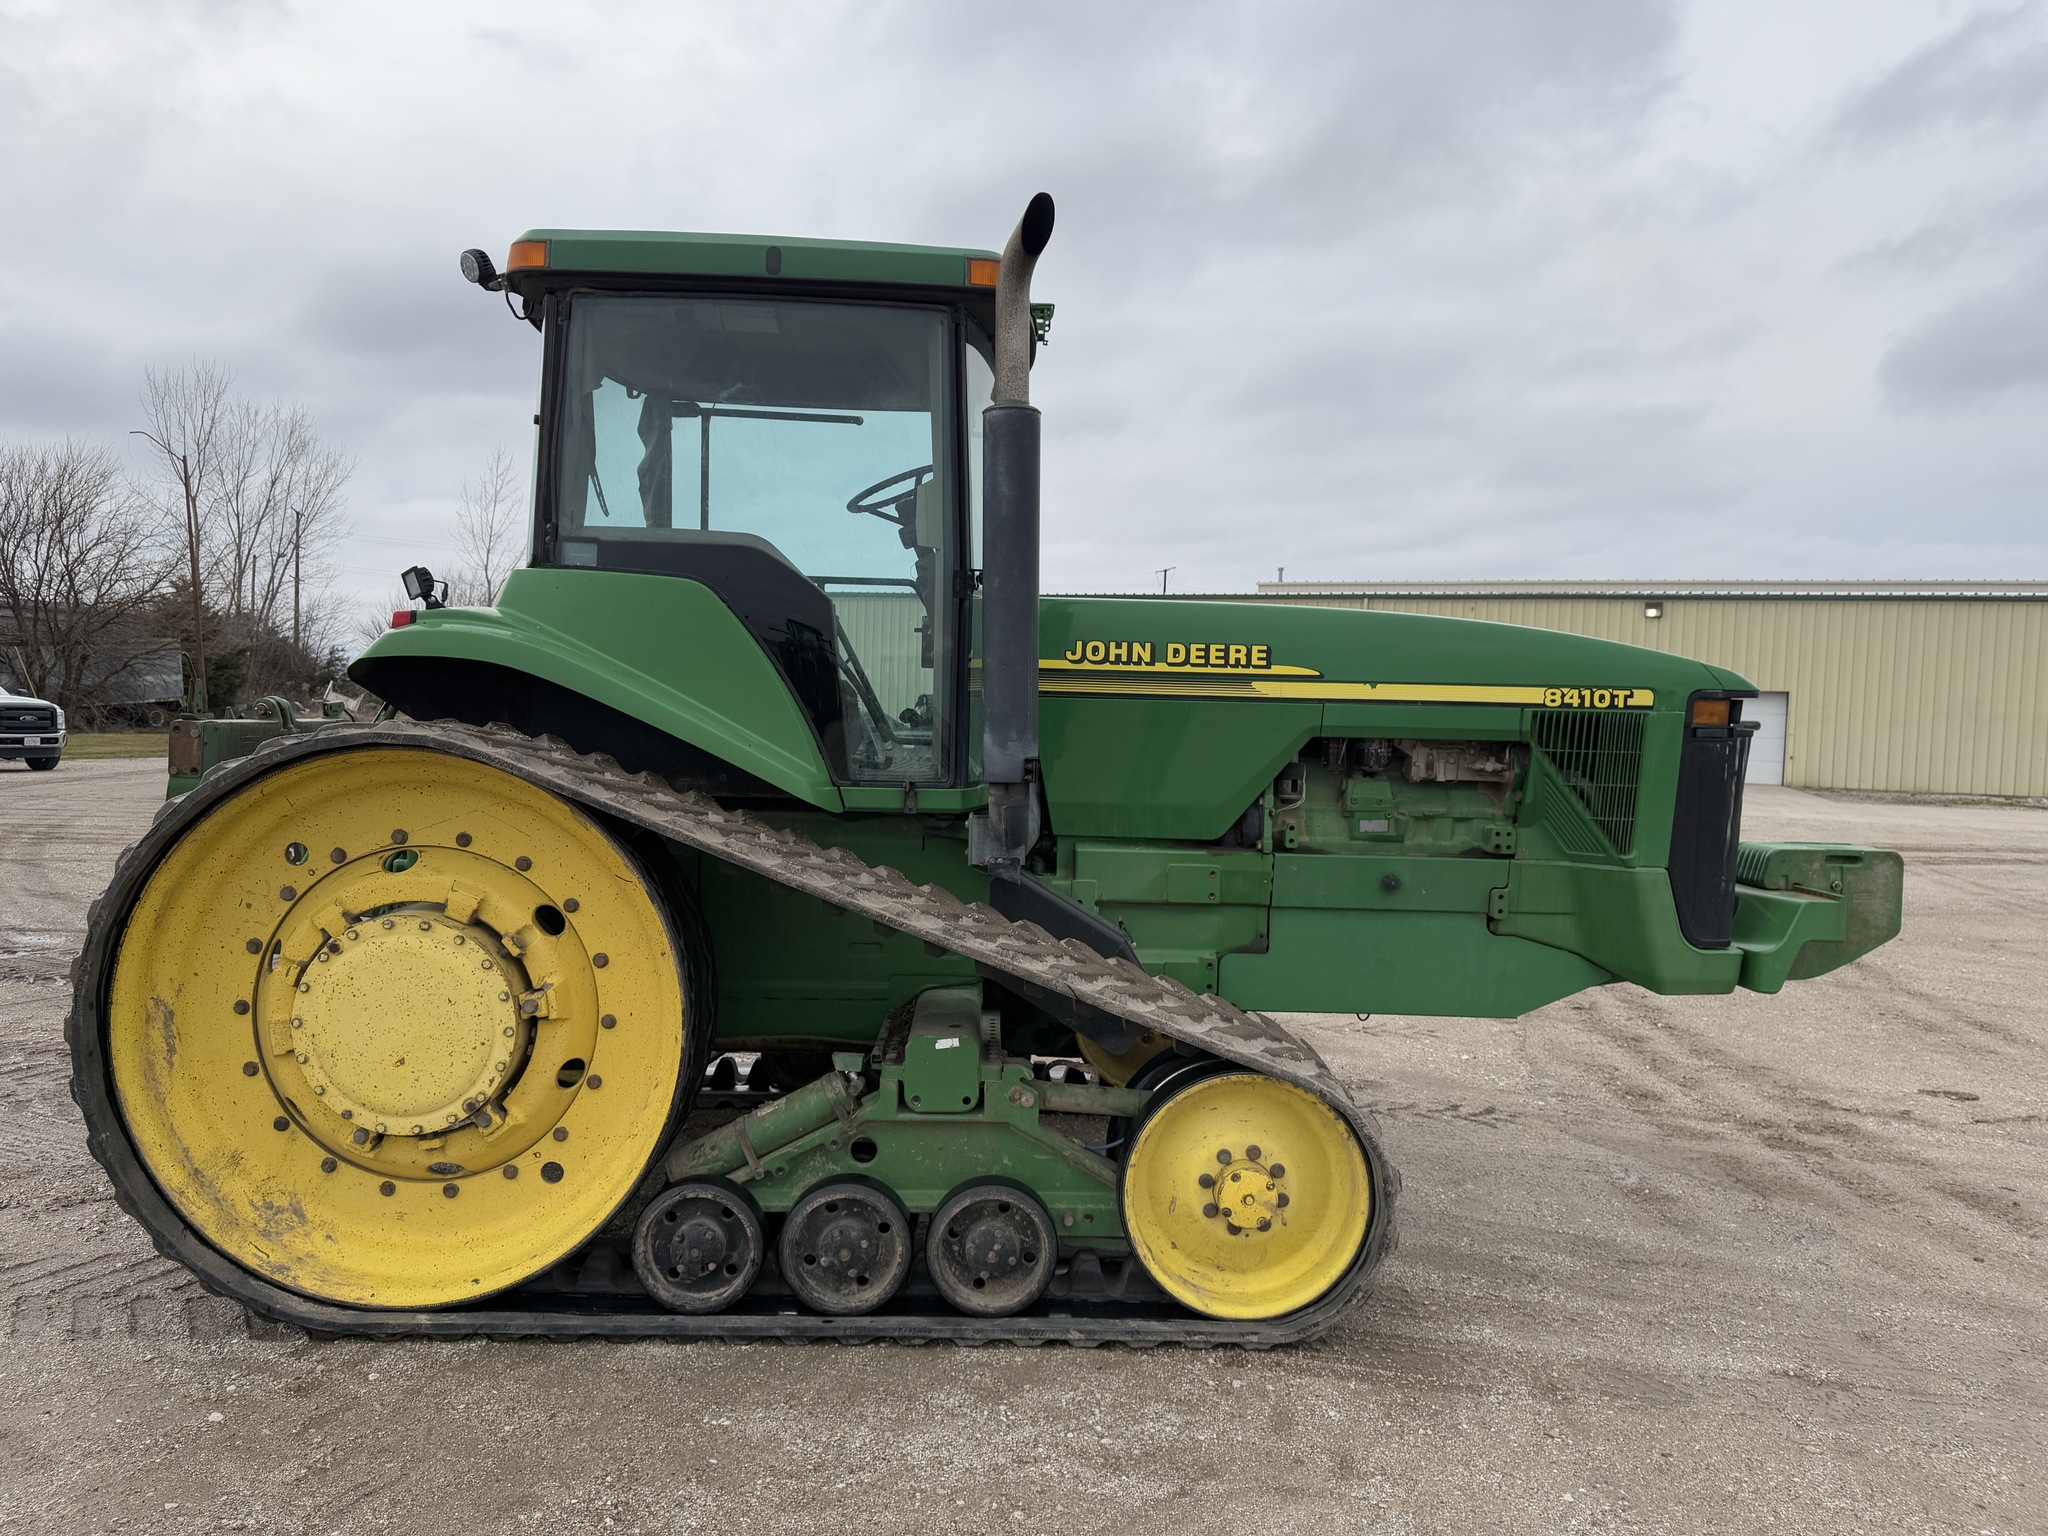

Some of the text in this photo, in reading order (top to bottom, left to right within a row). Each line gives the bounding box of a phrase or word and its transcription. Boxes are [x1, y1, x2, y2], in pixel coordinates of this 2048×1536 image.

[1065, 640, 1270, 668] JOHN DEERE
[1544, 687, 1632, 709] 8410T
